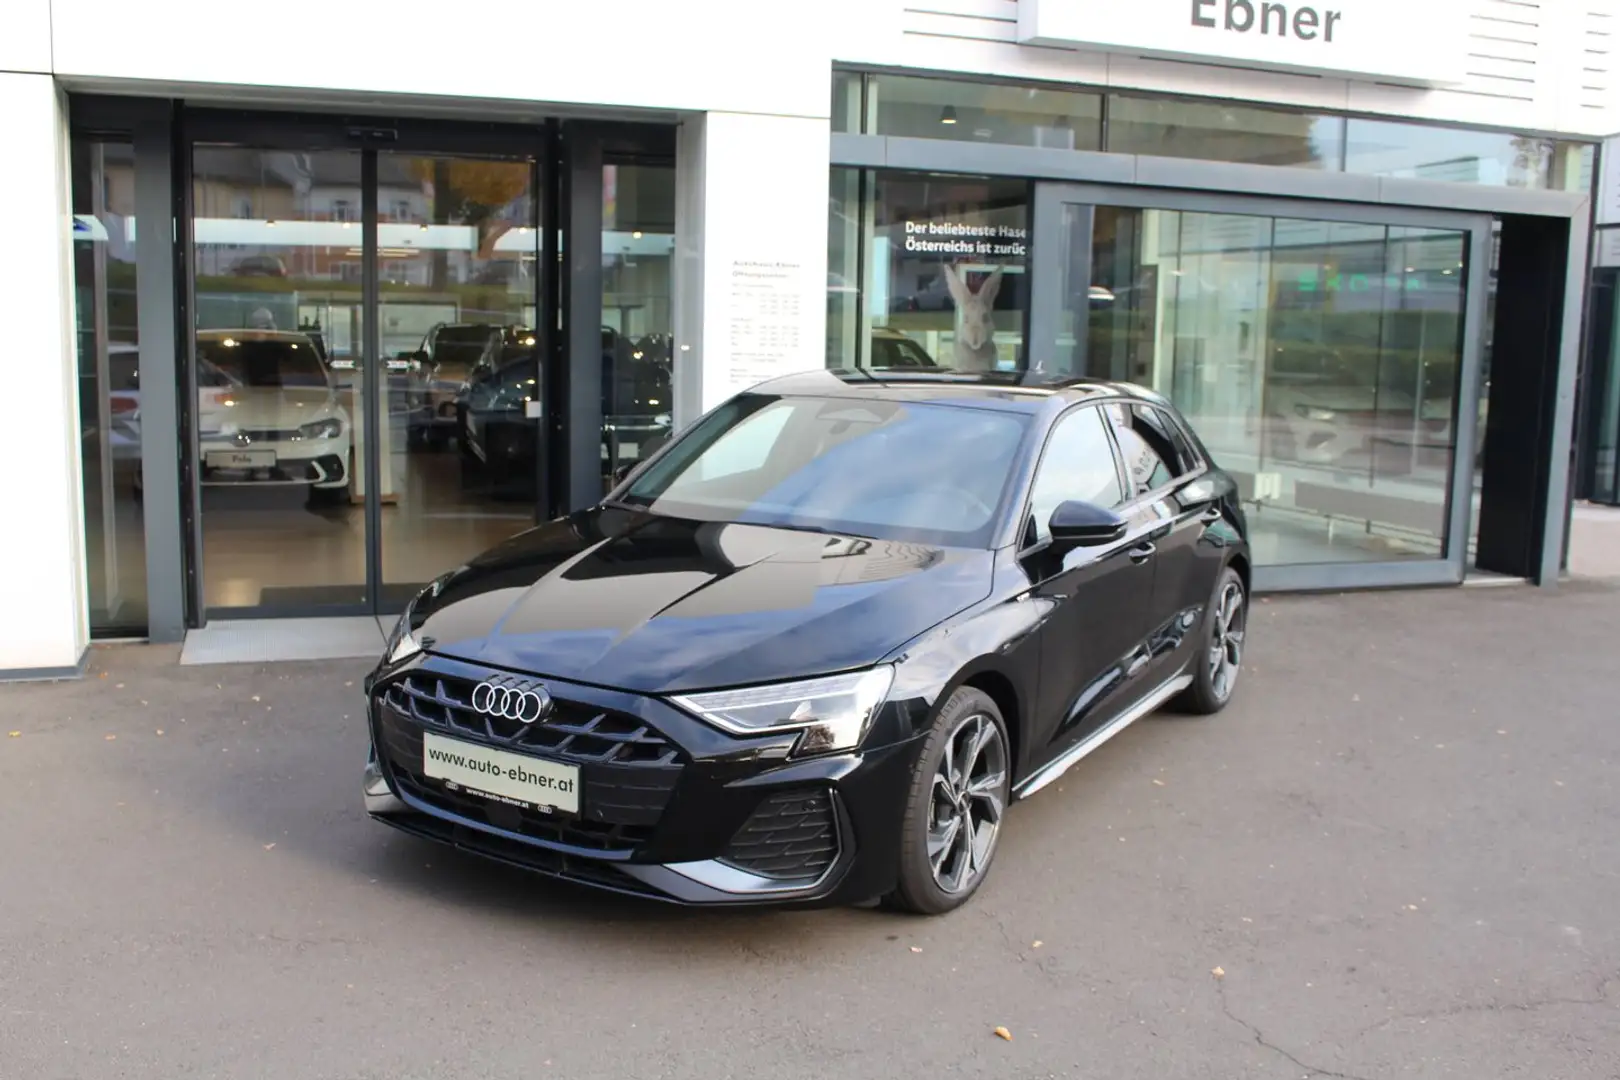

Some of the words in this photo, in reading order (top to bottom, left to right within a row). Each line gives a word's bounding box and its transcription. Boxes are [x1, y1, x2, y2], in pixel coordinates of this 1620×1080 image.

[1191, 0, 1341, 42] Ebner
[905, 221, 927, 234] Der
[929, 222, 996, 236] beliebteste
[905, 235, 974, 253] Österreichs
[976, 240, 992, 254] ist
[994, 241, 1026, 255] zurüc
[429, 747, 573, 793] www.auto-ebner.at
